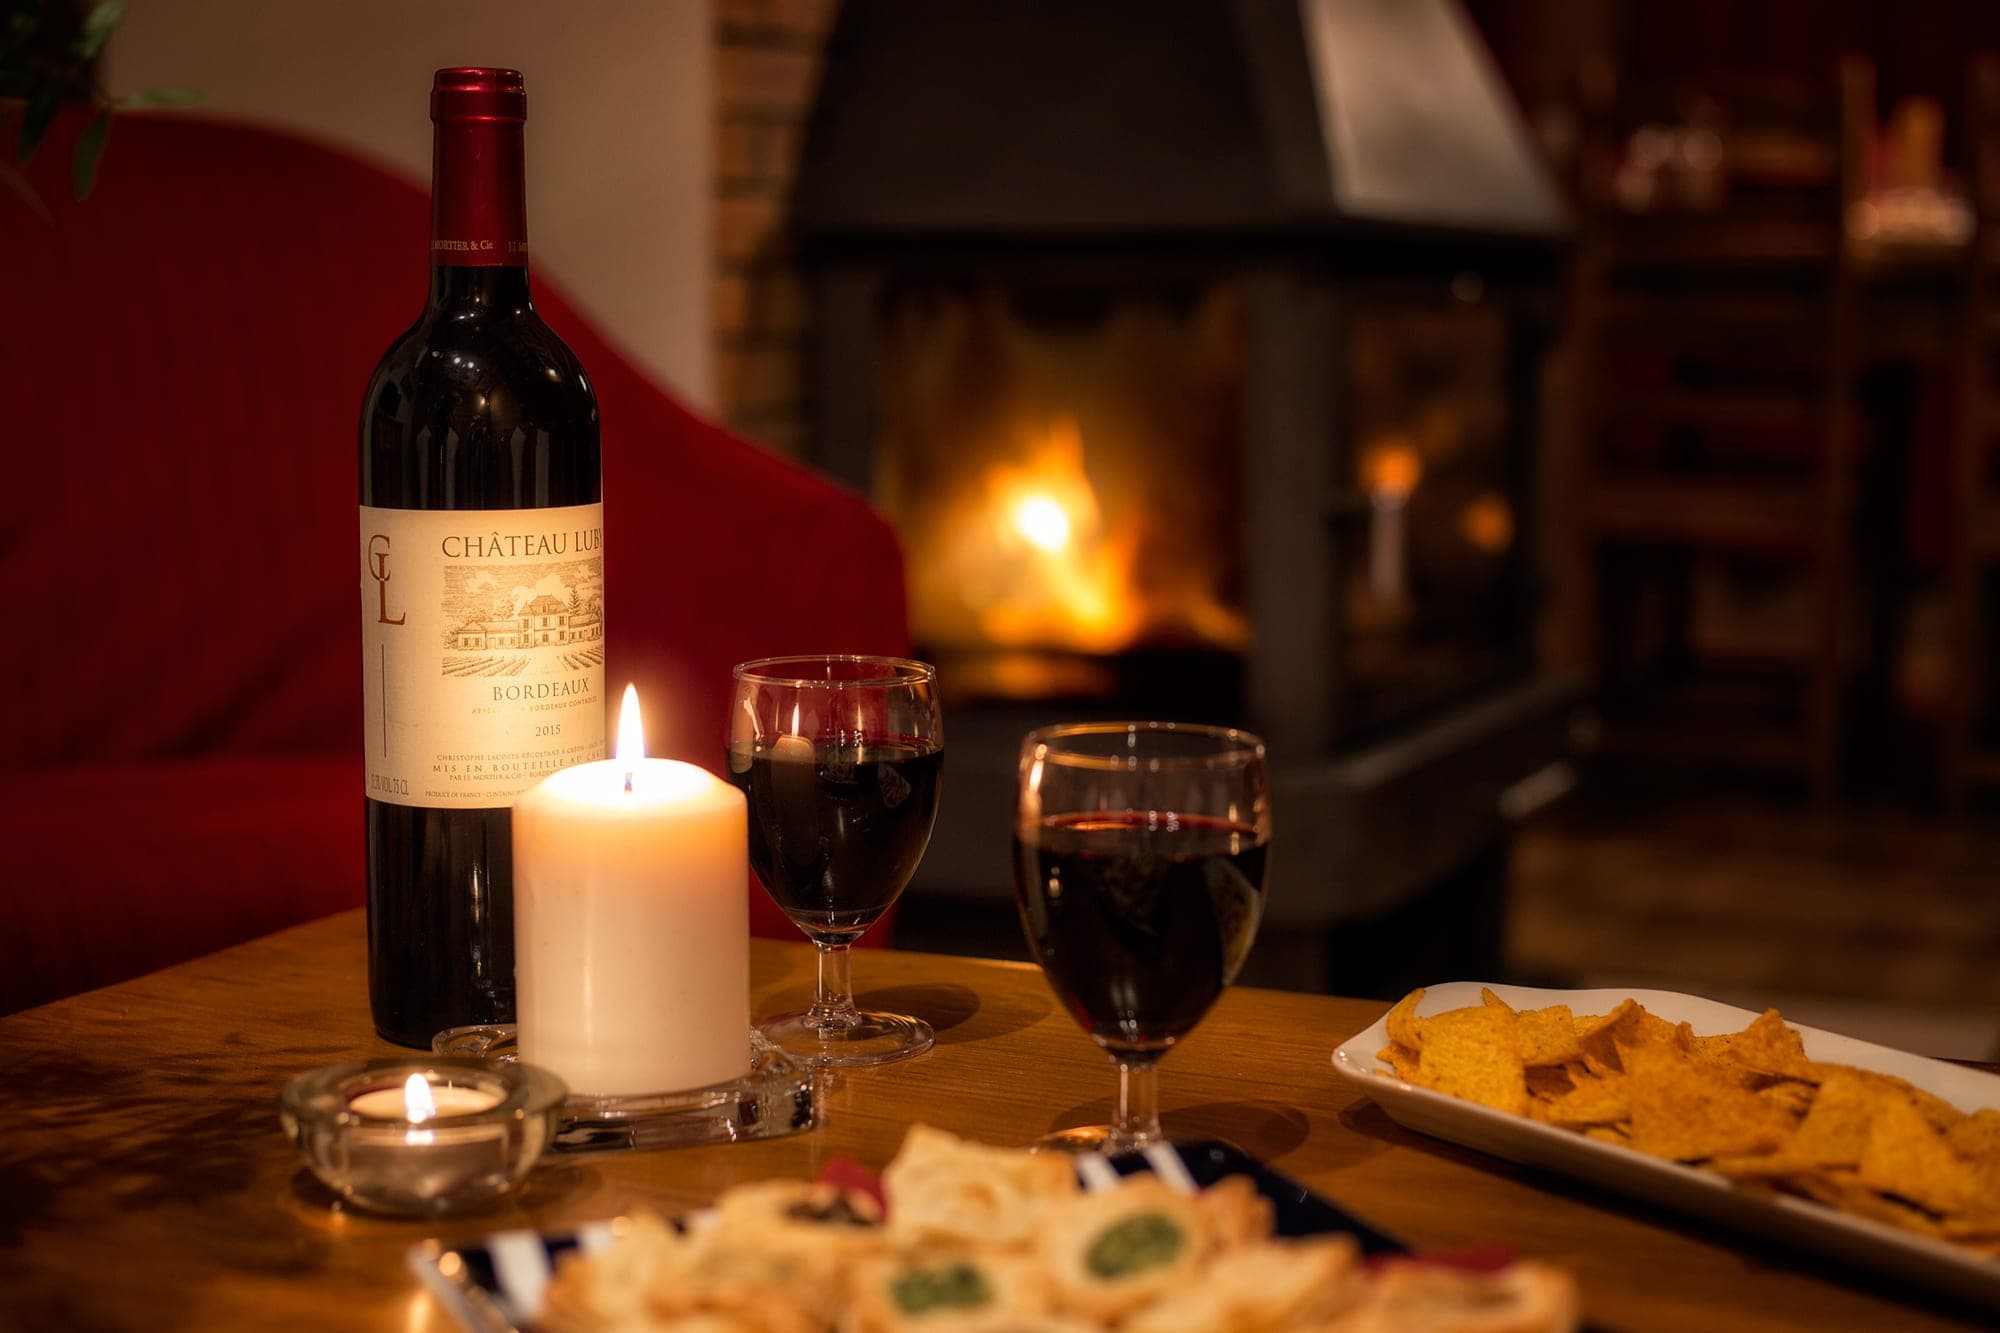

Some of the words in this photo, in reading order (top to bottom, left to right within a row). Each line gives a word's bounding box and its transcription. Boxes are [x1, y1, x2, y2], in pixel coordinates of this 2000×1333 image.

[441, 531, 567, 558] CHÂTEAU
[493, 677, 590, 701] BORDEAUX
[535, 724, 561, 737] 2015
[432, 764, 458, 773] MIS
[466, 764, 483, 773] EN
[492, 757, 564, 773] BOUTEILLE
[436, 753, 484, 762] CHRISTOPHE
